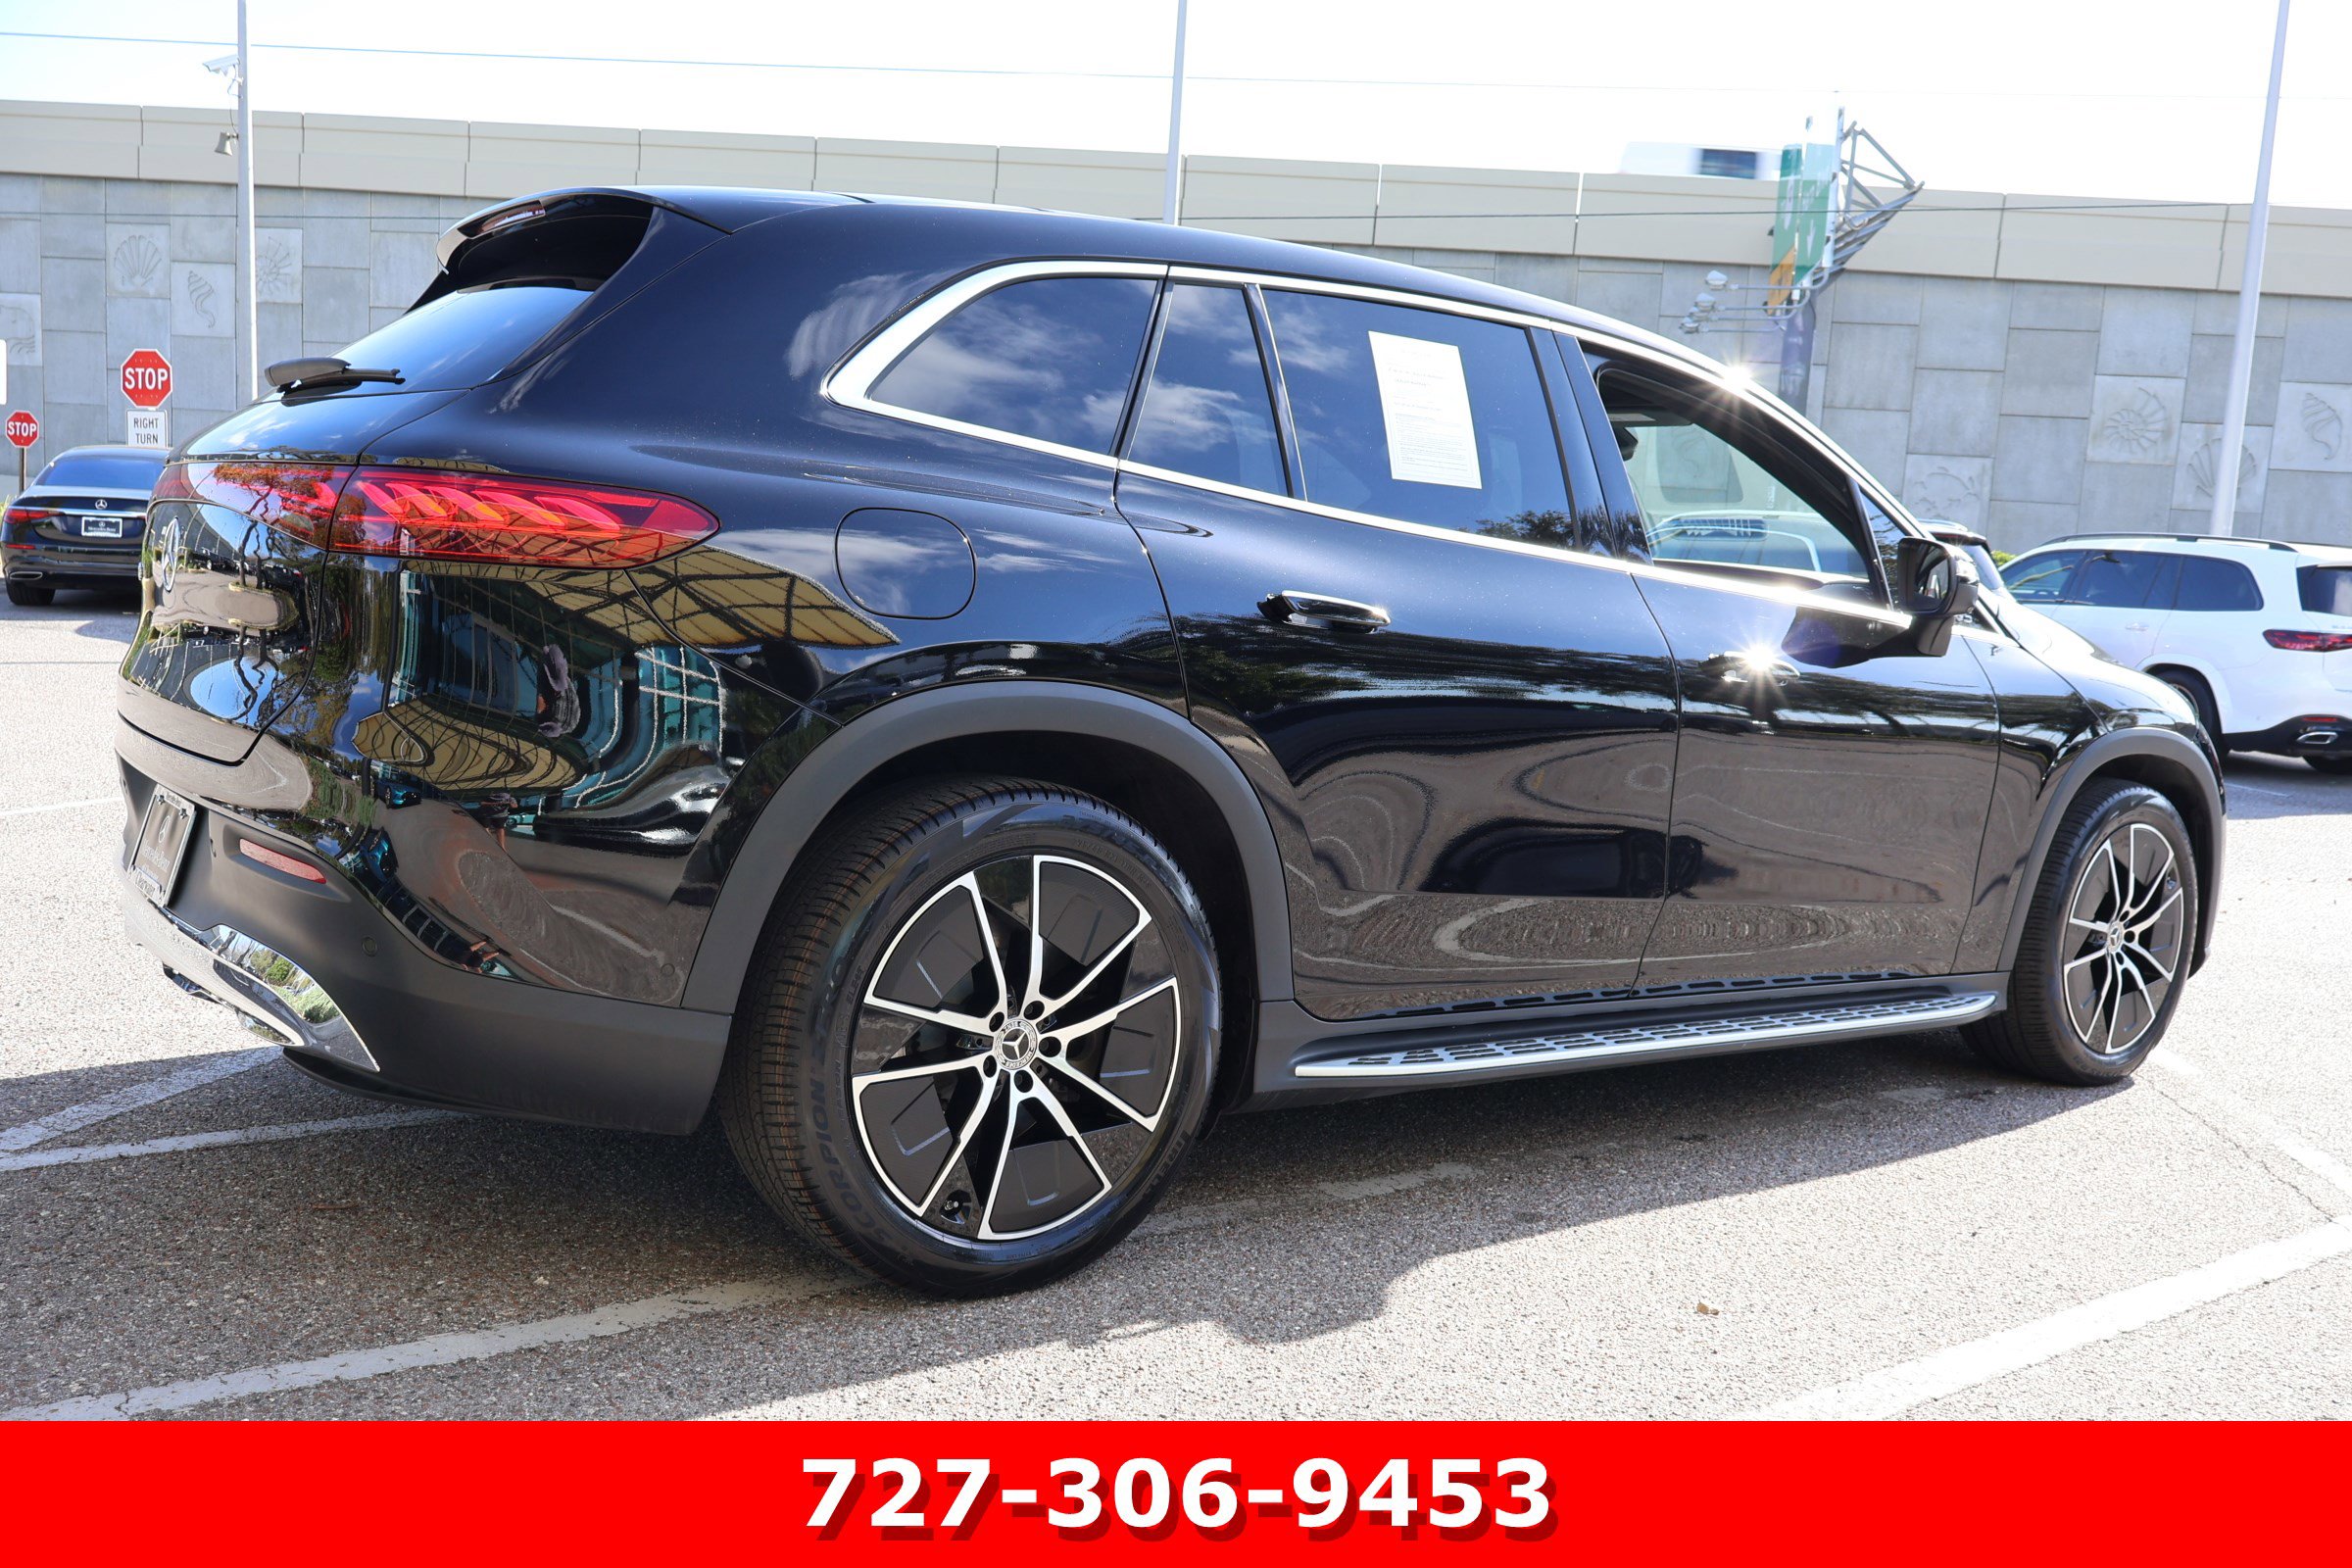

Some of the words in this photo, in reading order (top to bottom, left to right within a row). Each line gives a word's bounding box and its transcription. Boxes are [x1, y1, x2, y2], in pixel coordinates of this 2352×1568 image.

[124, 368, 169, 390] STOP
[8, 421, 37, 437] STOP
[133, 417, 159, 429] RIGHT
[135, 433, 159, 444] TURN
[809, 1077, 896, 1243] SCORPION
